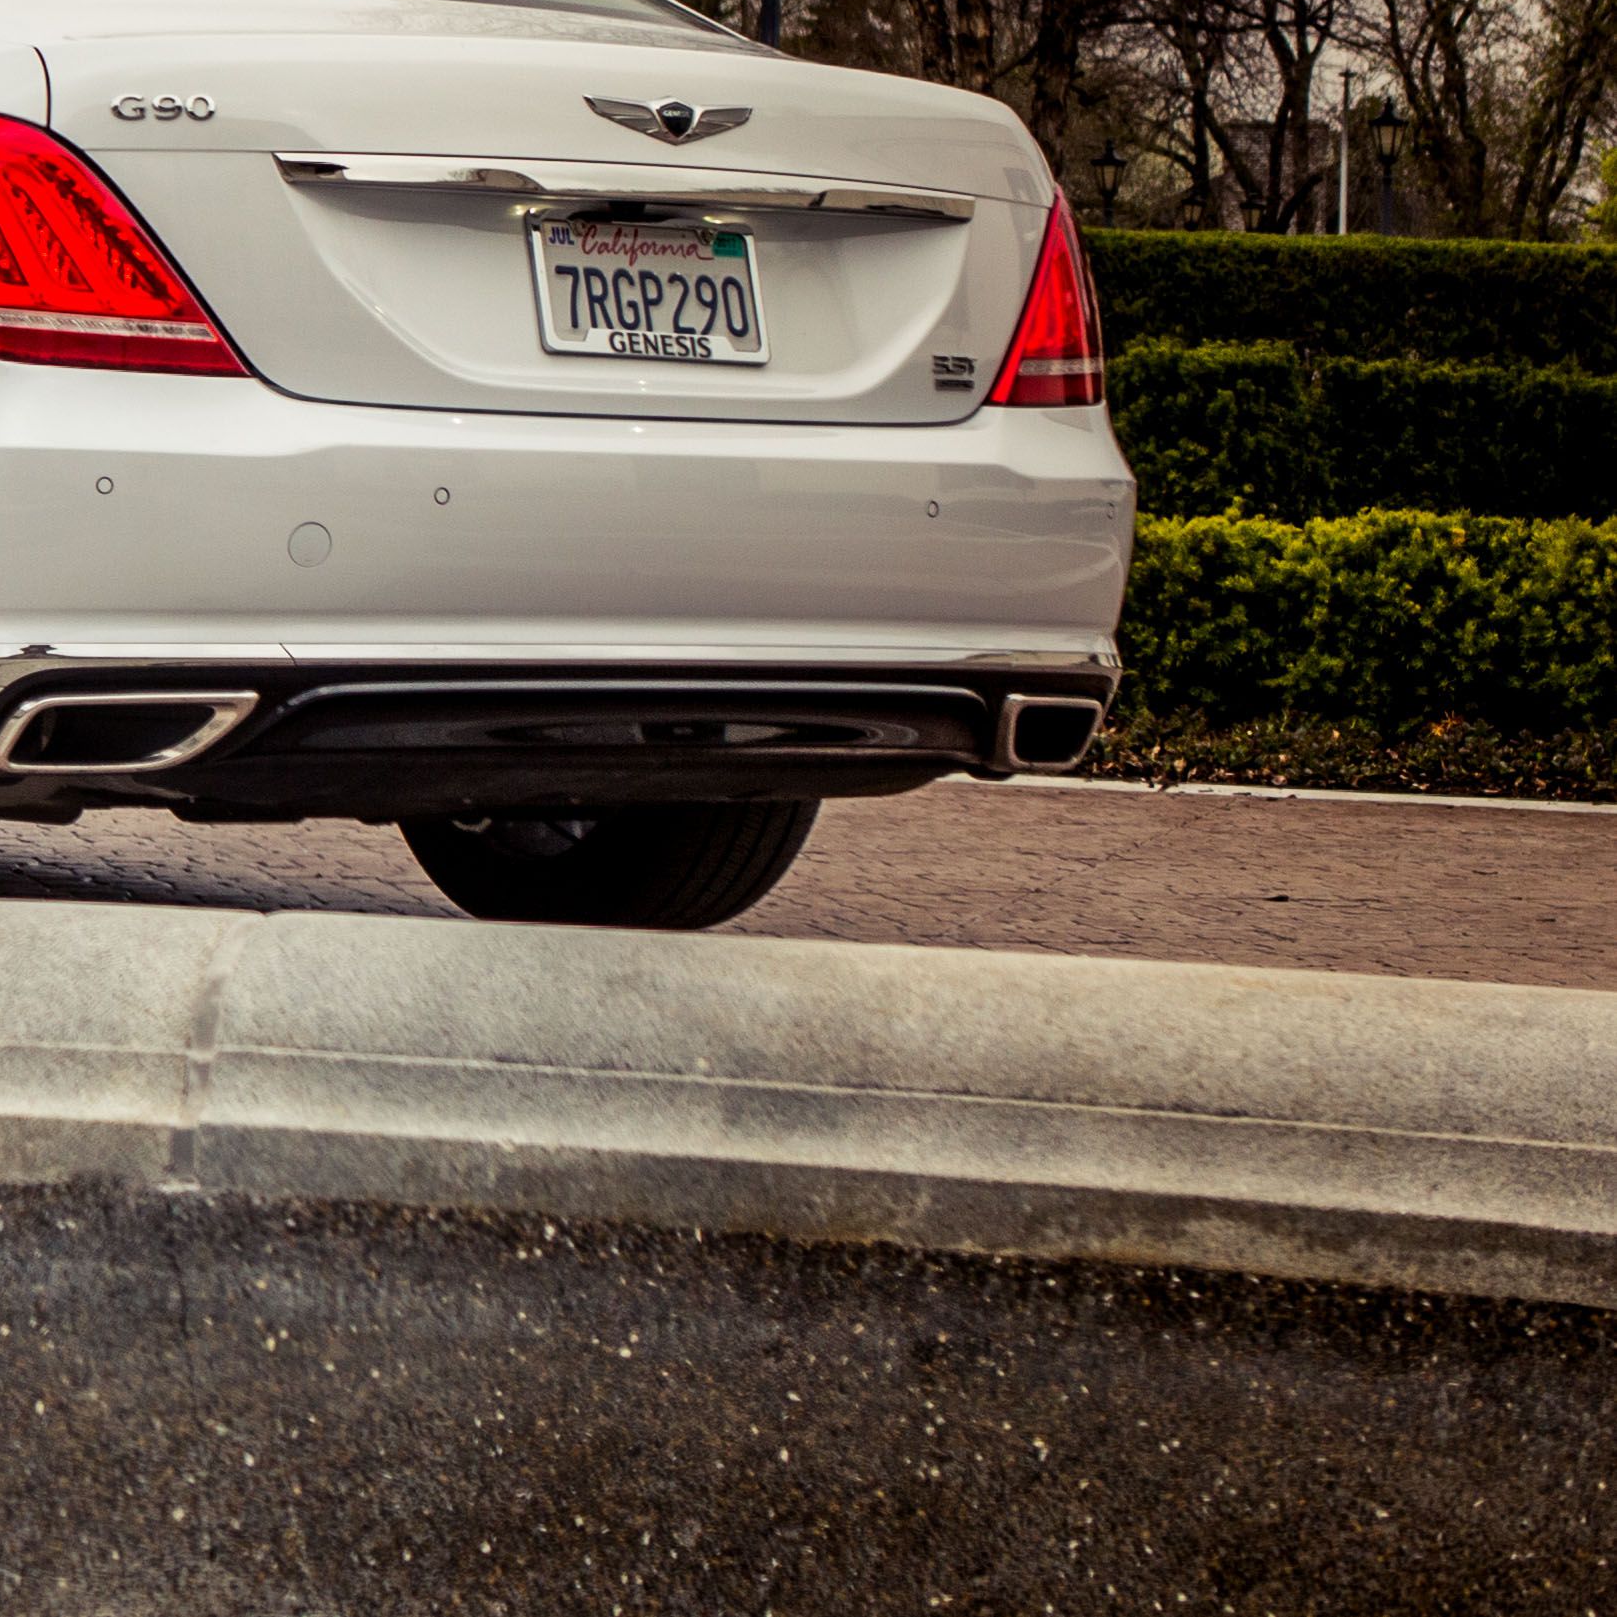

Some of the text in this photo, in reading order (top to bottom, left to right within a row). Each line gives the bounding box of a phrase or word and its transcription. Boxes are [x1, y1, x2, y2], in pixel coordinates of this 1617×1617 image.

[110, 94, 215, 121] G90
[548, 226, 574, 245] JUL
[581, 225, 714, 266] California
[554, 265, 750, 337] 7RGP290
[609, 331, 712, 358] GENESIS
